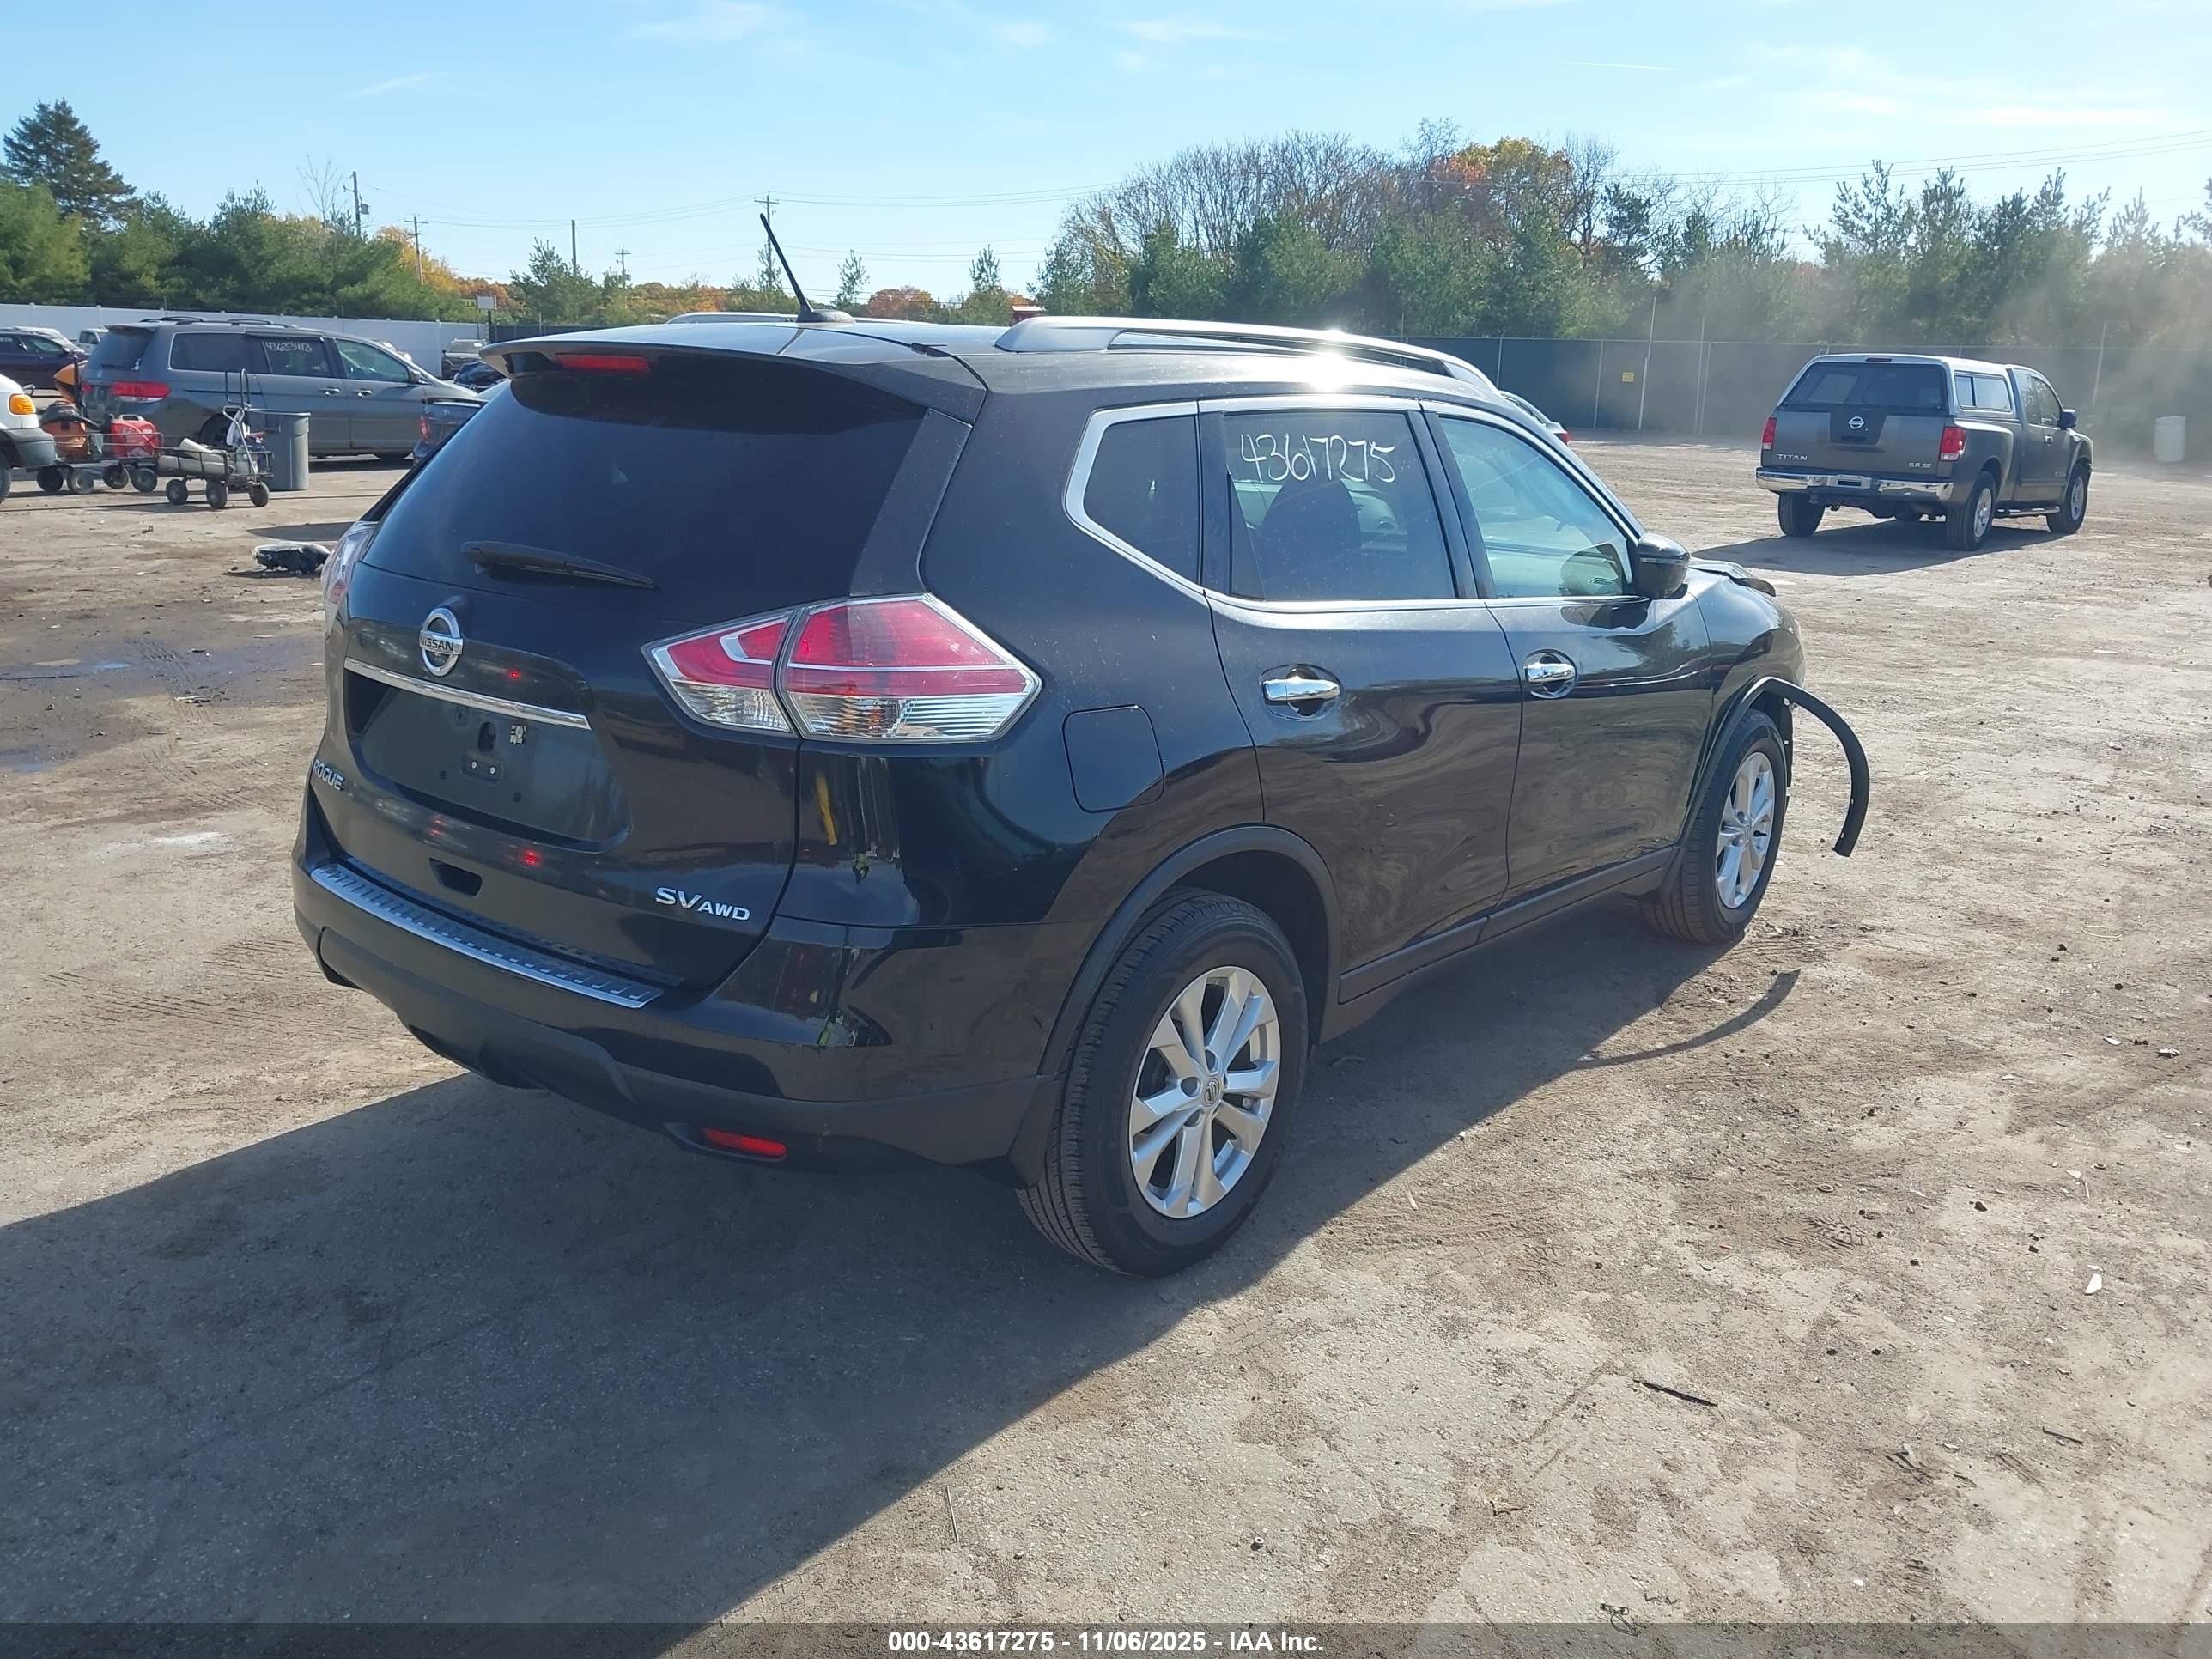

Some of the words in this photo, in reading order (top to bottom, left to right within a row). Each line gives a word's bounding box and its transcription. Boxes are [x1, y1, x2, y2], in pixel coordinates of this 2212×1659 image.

[1241, 433, 1395, 483] 43617275
[422, 635, 454, 652] NISSAN
[313, 759, 344, 791] ROGUE
